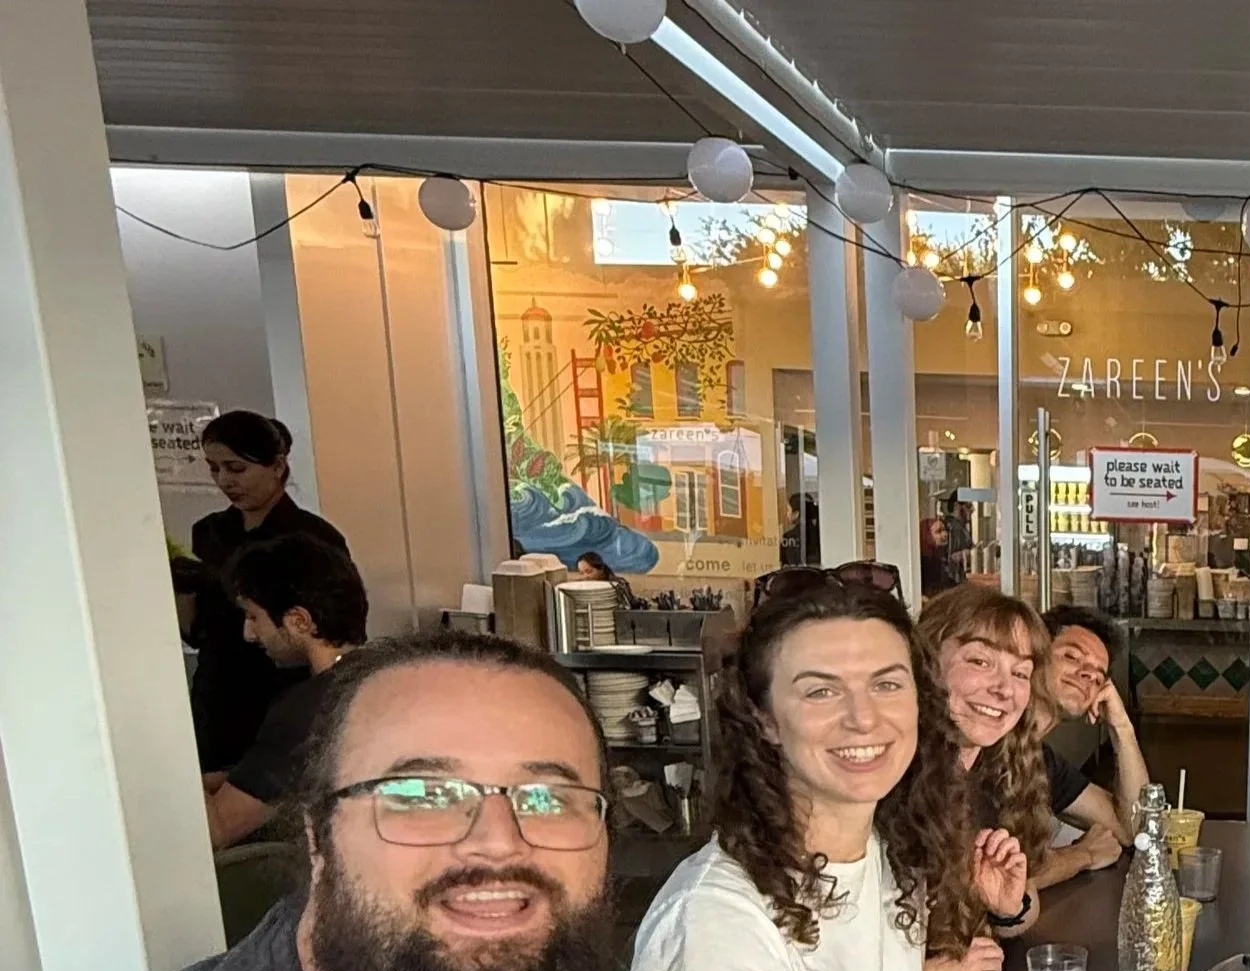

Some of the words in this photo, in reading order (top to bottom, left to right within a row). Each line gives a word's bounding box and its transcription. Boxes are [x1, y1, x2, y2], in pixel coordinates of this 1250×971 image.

[1057, 356, 1222, 402] ZAREEN'S
[162, 417, 195, 434] wait
[1106, 459, 1148, 475] please
[1152, 461, 1181, 474] wait
[1104, 475, 1117, 487] to
[1121, 477, 1136, 488] be
[1139, 476, 1184, 490] seated
[1024, 494, 1035, 535] PULL
[685, 557, 731, 572] come
